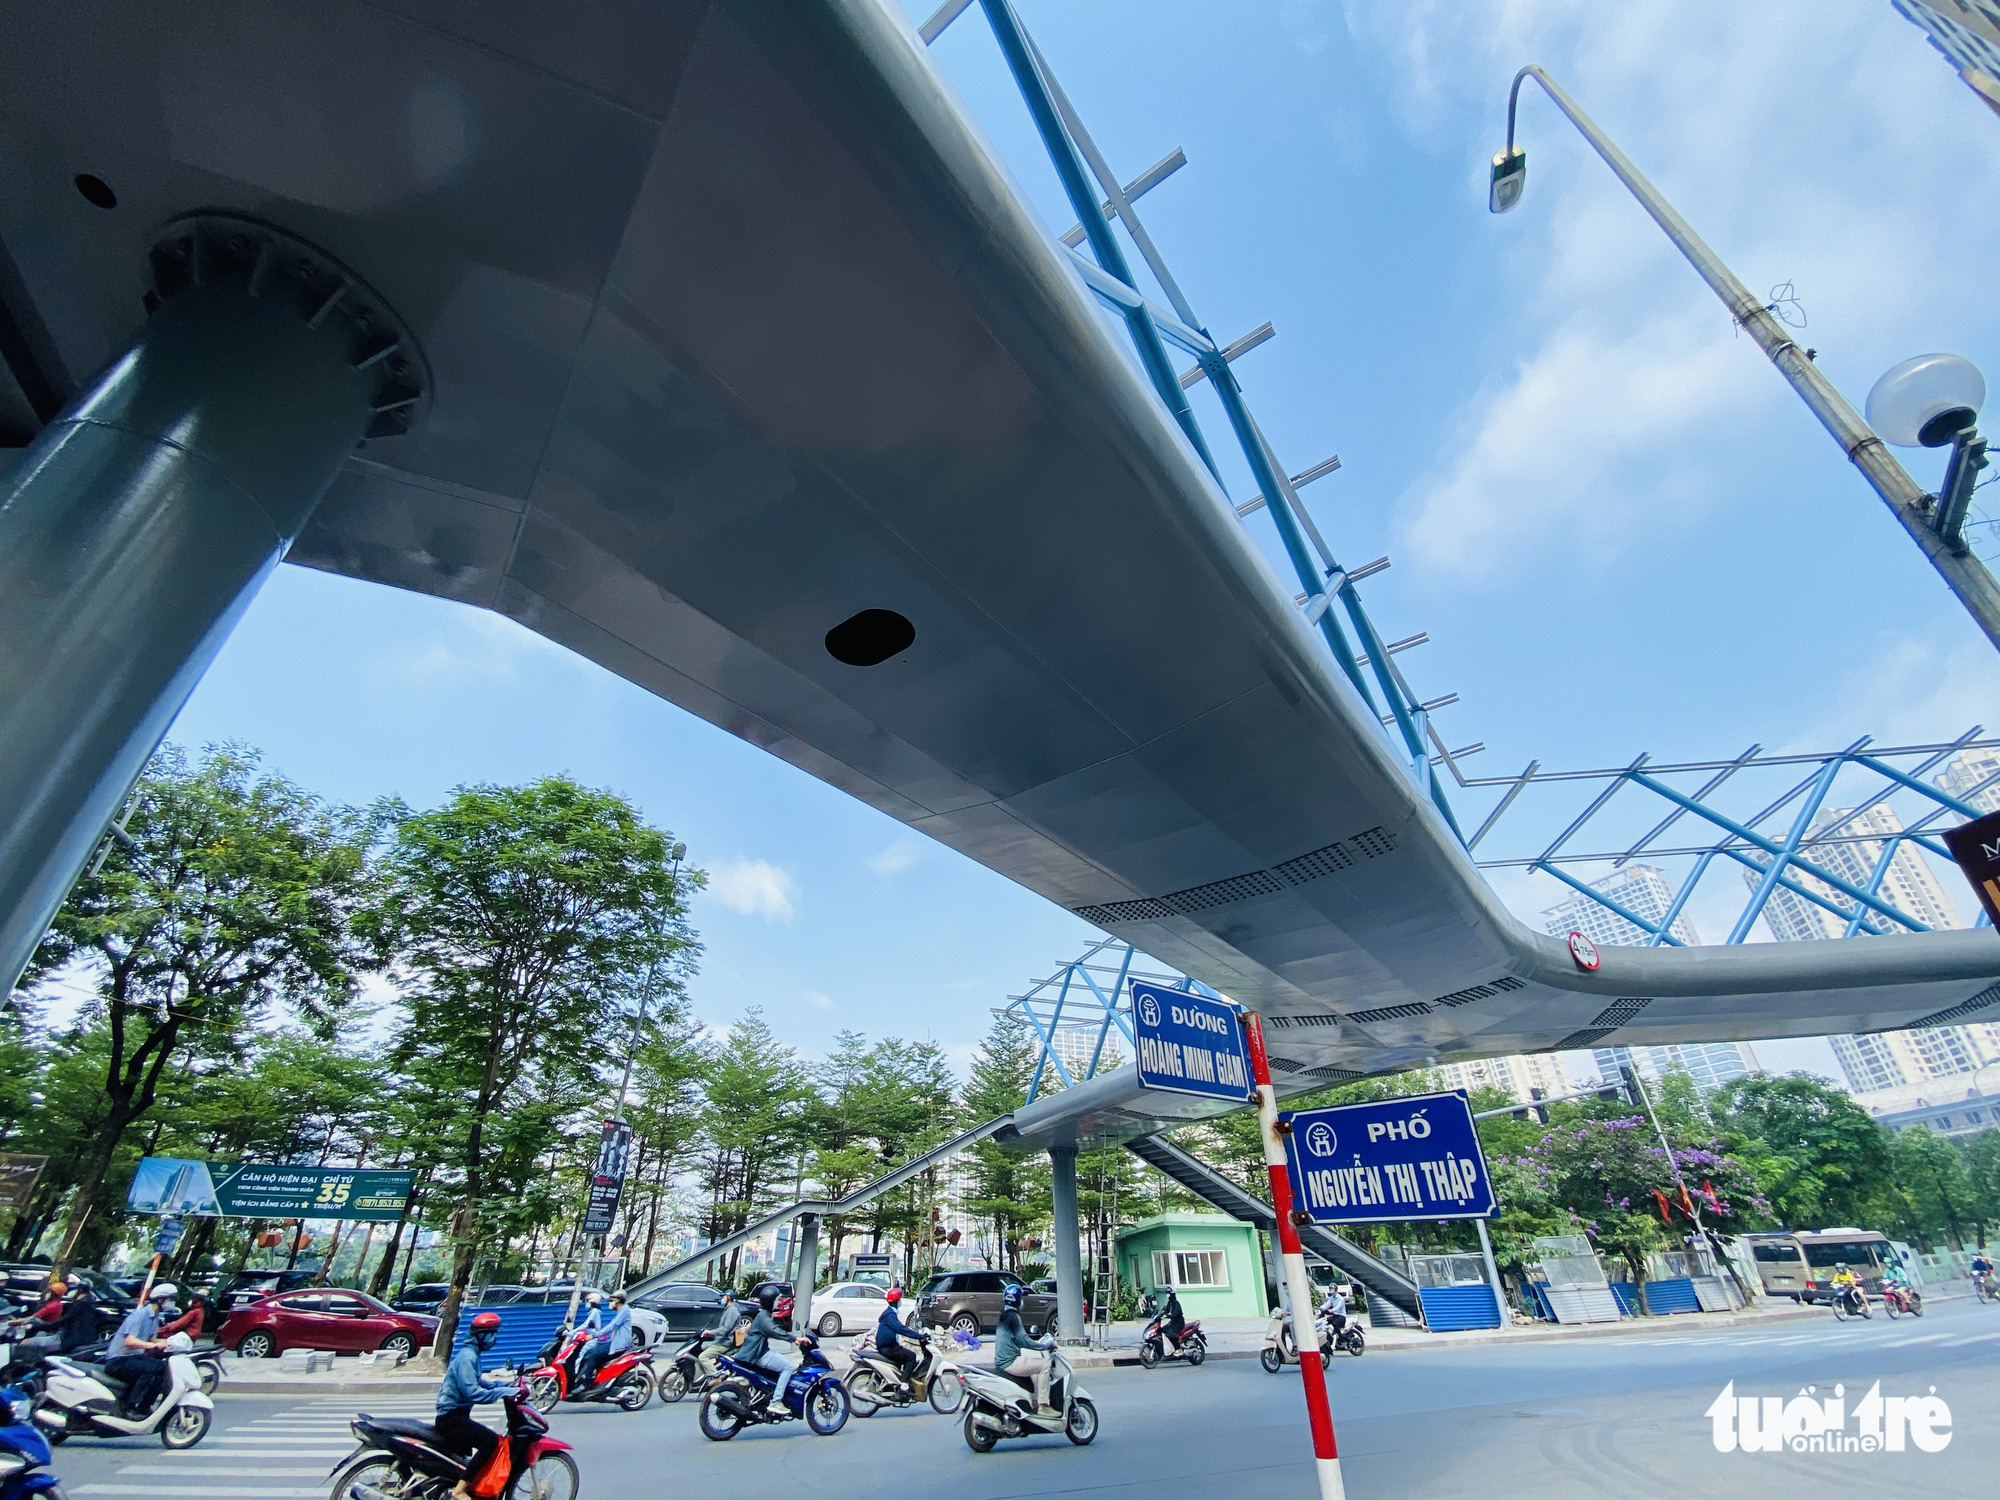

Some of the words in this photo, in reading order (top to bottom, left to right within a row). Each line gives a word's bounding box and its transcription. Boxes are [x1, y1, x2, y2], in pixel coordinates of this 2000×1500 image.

[1171, 1005, 1228, 1035] ĐƯỜNG
[1140, 1033, 1183, 1078] HOÀNG
[1182, 1045, 1216, 1083] MINH
[1215, 1048, 1246, 1088] GIÁM
[1367, 1108, 1432, 1143] PHỐ
[262, 1173, 277, 1183] HỘ
[278, 1174, 300, 1184] HIỆN
[315, 1183, 352, 1203] 35
[1307, 1153, 1386, 1208] NGUYỄN
[1384, 1163, 1424, 1208] THỊ
[1419, 1152, 1477, 1206] THẬP
